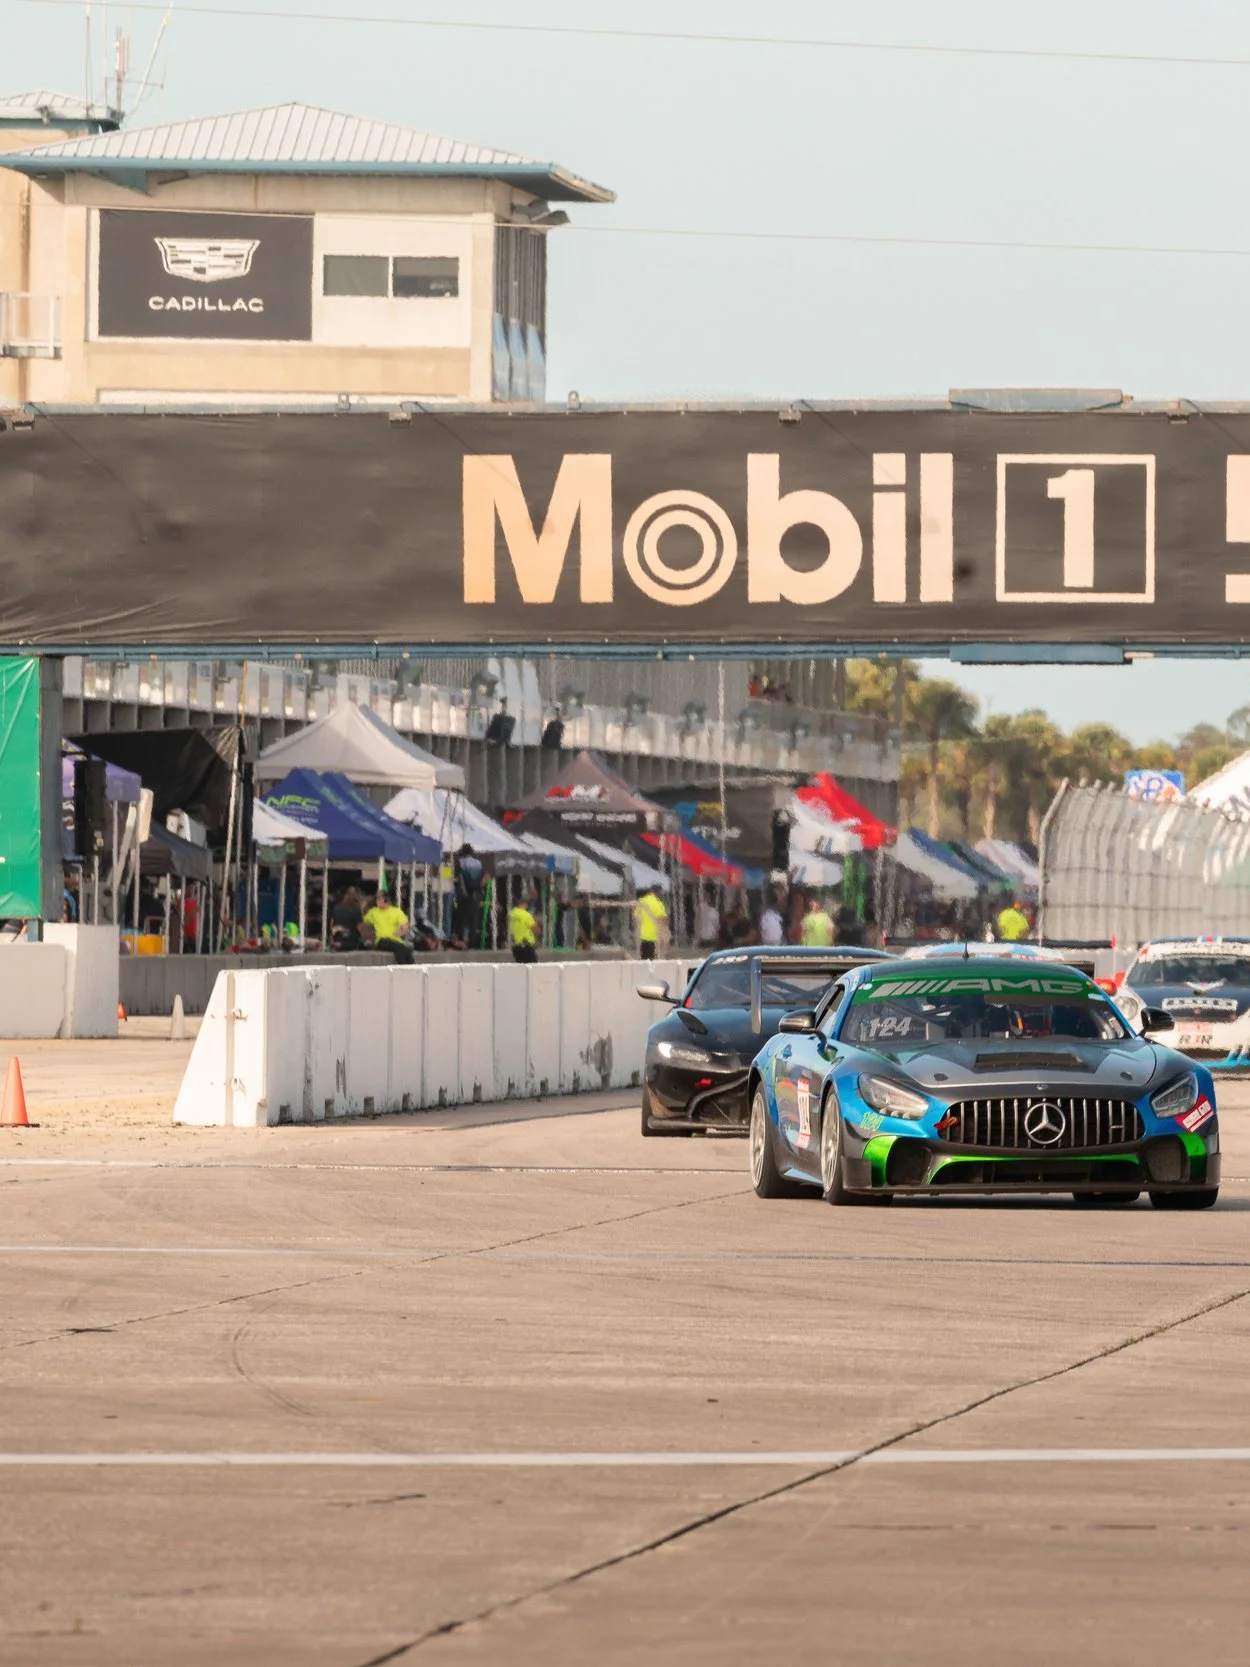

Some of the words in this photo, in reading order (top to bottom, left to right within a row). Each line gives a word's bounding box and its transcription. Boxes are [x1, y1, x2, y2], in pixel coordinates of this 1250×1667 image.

[149, 296, 264, 313] CADILLAC
[462, 453, 953, 606] Mobil
[941, 978, 1084, 994] AMG
[869, 1016, 913, 1037] 124
[861, 1111, 885, 1131] 124
